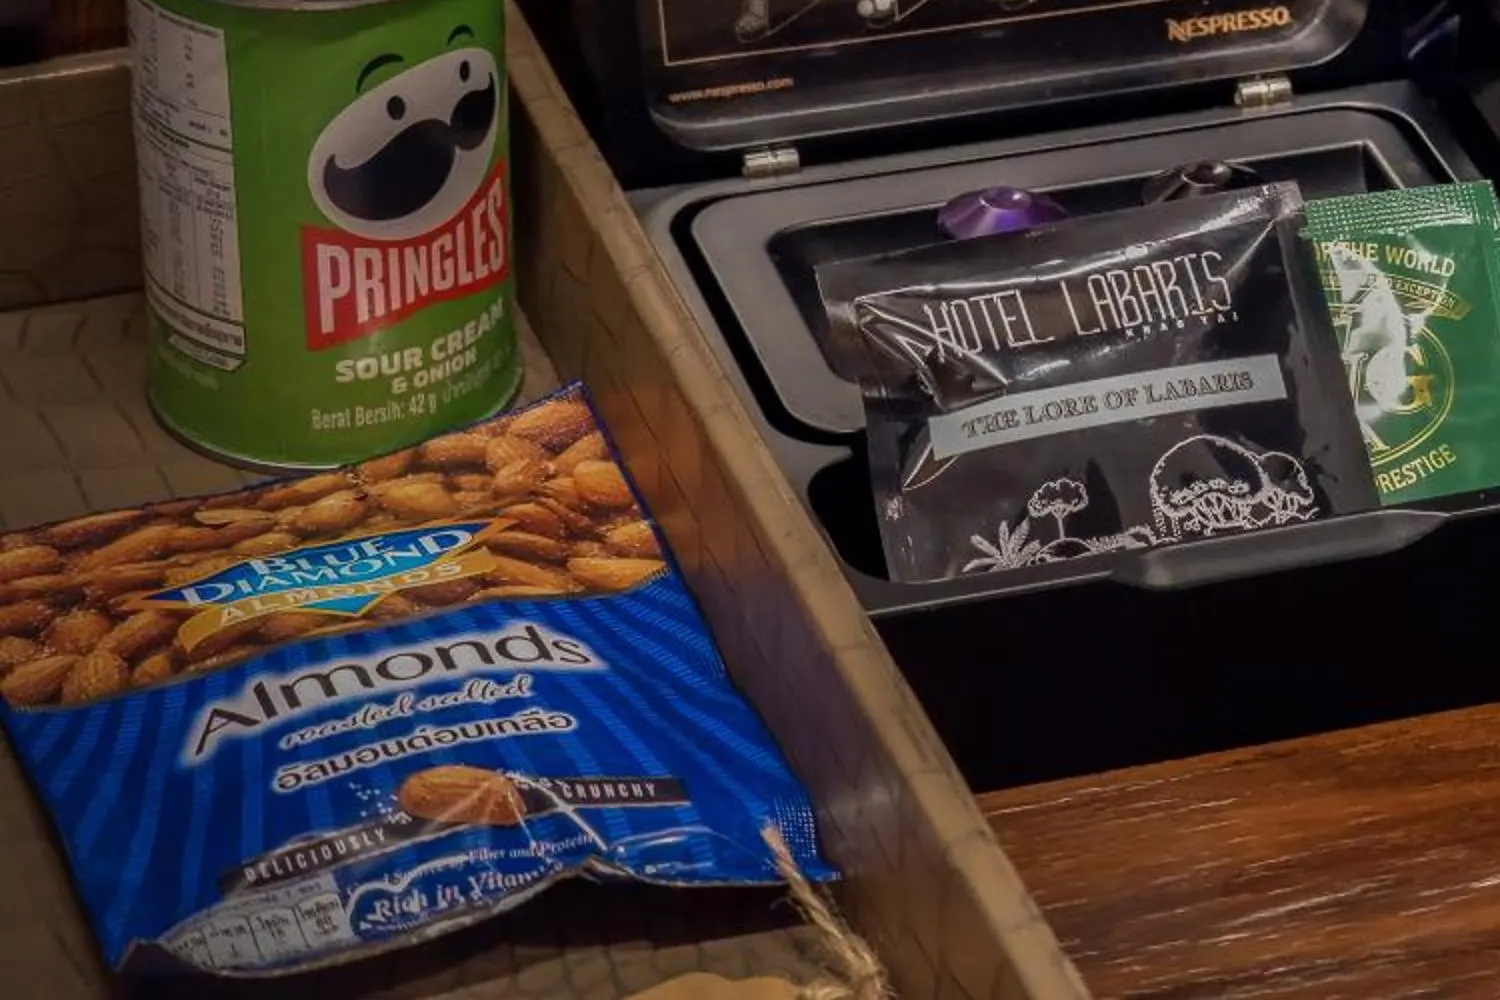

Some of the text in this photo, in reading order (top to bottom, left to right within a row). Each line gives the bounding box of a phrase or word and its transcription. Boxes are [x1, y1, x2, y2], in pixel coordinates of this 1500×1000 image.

[1167, 5, 1291, 42] NESPRESSO
[668, 75, 794, 103] www.nespresso.com
[315, 177, 505, 334] PRINGLES
[1385, 245, 1456, 277] WORLD
[924, 251, 1232, 363] HOTEL LABARIS
[335, 347, 423, 383] SOUR
[391, 377, 408, 394] &
[413, 346, 478, 388] ONION
[311, 407, 351, 431] Berat
[355, 401, 405, 428] Bersih:
[409, 395, 424, 415] 42
[961, 371, 1254, 438] THE LORE OF LABARIS
[1375, 444, 1457, 494] RESTIGE
[181, 529, 474, 607] DIAMOND
[249, 537, 385, 576] BLUE
[219, 562, 464, 627] ALMONDS
[194, 625, 592, 757] Almonds
[282, 675, 531, 748] roasted salted
[243, 782, 658, 882] DELICIOUSLY CRUNCHY
[368, 888, 428, 922] Rich
